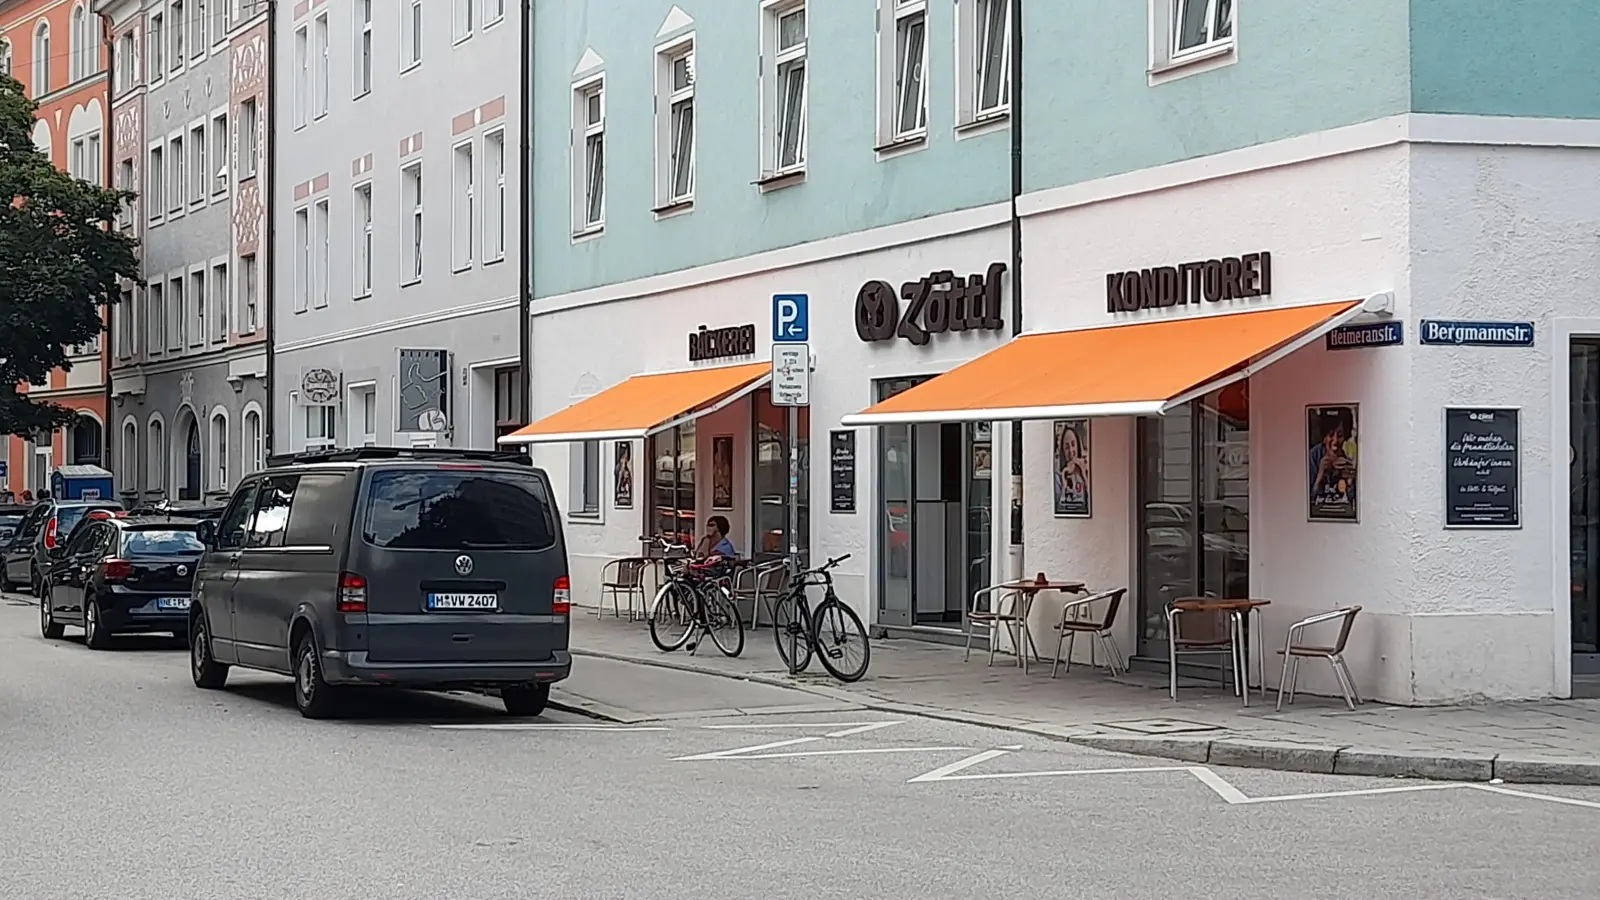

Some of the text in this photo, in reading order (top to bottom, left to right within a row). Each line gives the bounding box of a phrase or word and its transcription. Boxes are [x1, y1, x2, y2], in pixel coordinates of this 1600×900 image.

[1106, 251, 1271, 313] KONDITOREI
[778, 300, 798, 336] P
[898, 262, 1007, 345] Zöttl
[689, 324, 755, 361] BÄCKEREI
[1331, 327, 1397, 345] Heimeranstr.
[1429, 322, 1529, 343] Bergmannstr.
[436, 595, 444, 607] M
[468, 595, 495, 607] 2407
